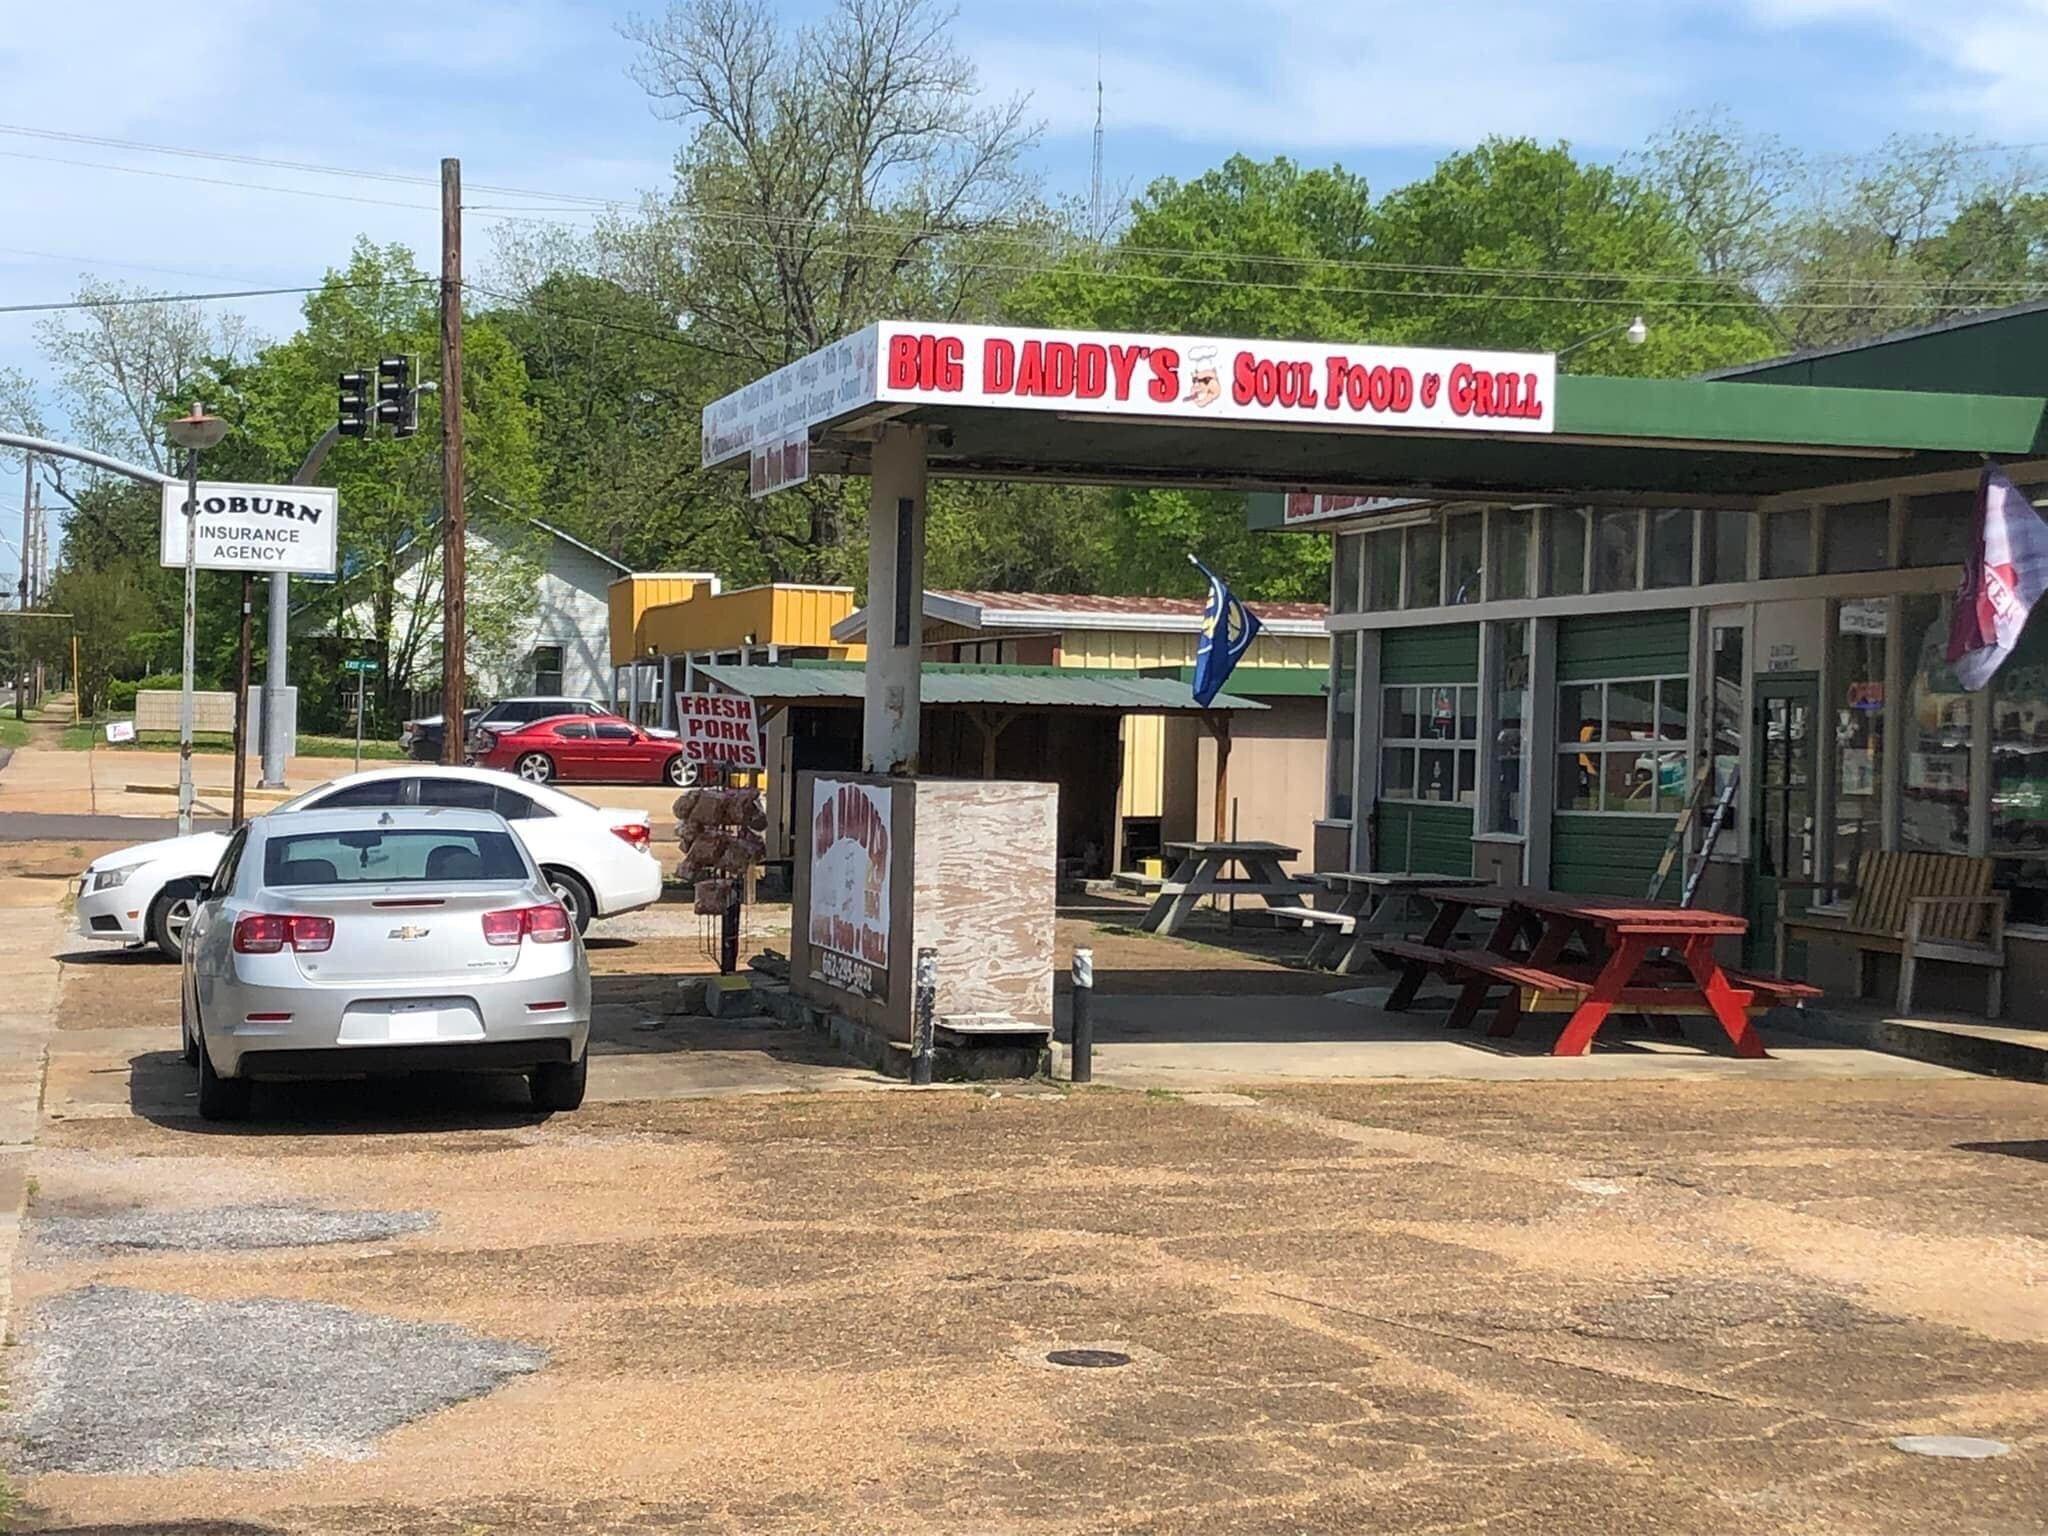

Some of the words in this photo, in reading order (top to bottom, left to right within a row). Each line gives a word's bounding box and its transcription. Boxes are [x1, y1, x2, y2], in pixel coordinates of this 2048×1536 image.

[888, 335, 965, 391] BIG
[982, 338, 1180, 402] DADDY'S
[1232, 351, 1317, 408] SOUL
[1325, 356, 1413, 413] FOOD
[1420, 372, 1440, 407] &
[1450, 362, 1542, 420] GRILL
[181, 497, 322, 525] COBURN
[200, 525, 300, 543] INSURANCE
[213, 545, 286, 560] AGENCY
[681, 696, 752, 719] FRESH
[688, 718, 751, 742] PORK
[686, 740, 756, 765] SKINS
